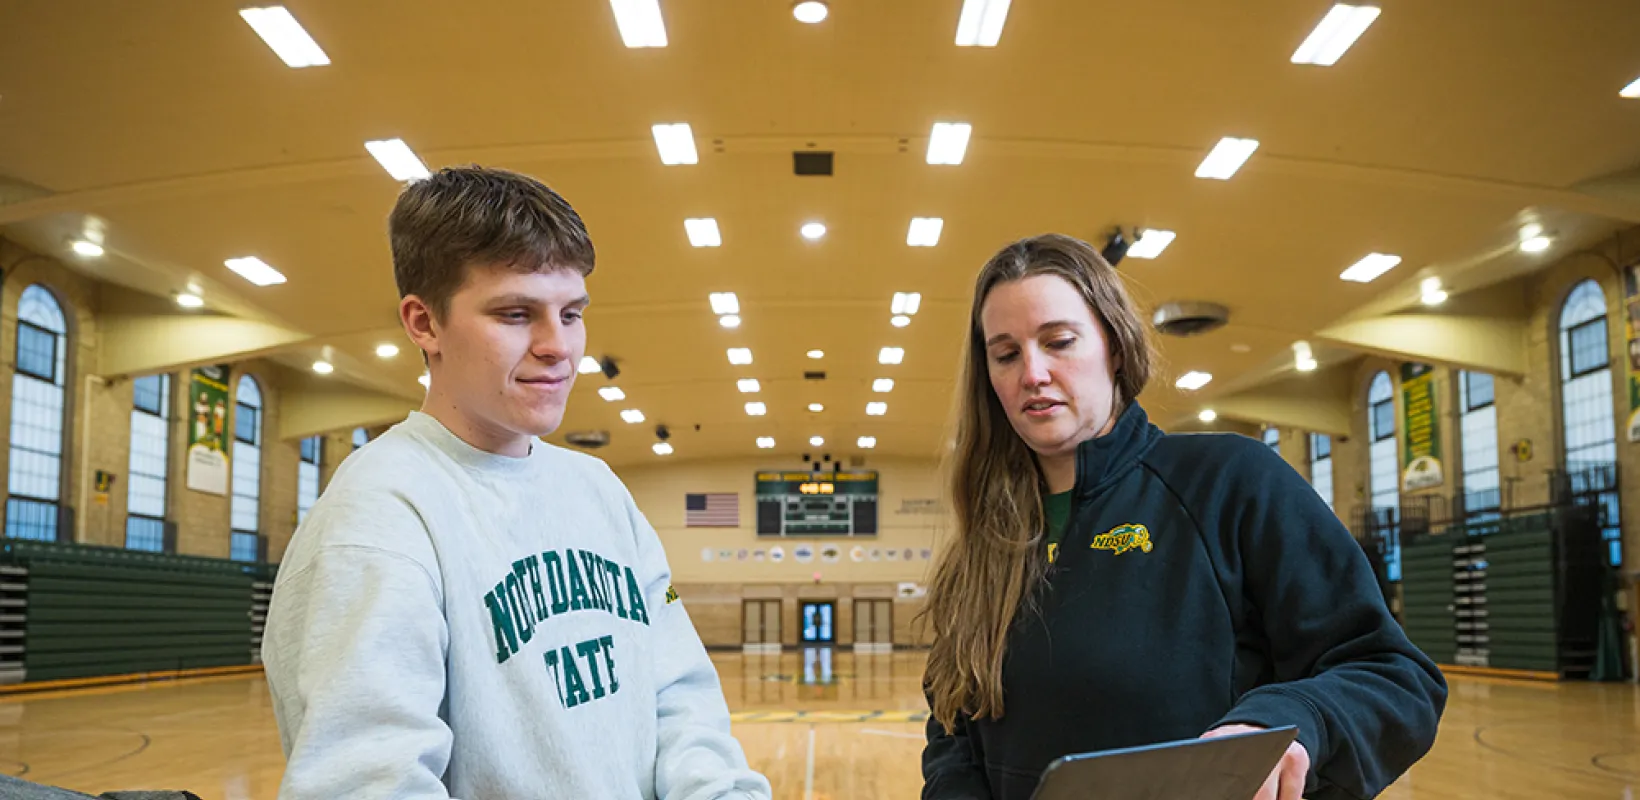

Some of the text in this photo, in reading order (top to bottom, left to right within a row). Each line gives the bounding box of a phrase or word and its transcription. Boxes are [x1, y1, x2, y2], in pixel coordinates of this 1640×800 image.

[1093, 533, 1131, 547] NDSU
[483, 548, 650, 665] NOTH DAKOTA
[543, 634, 620, 709] TATE
